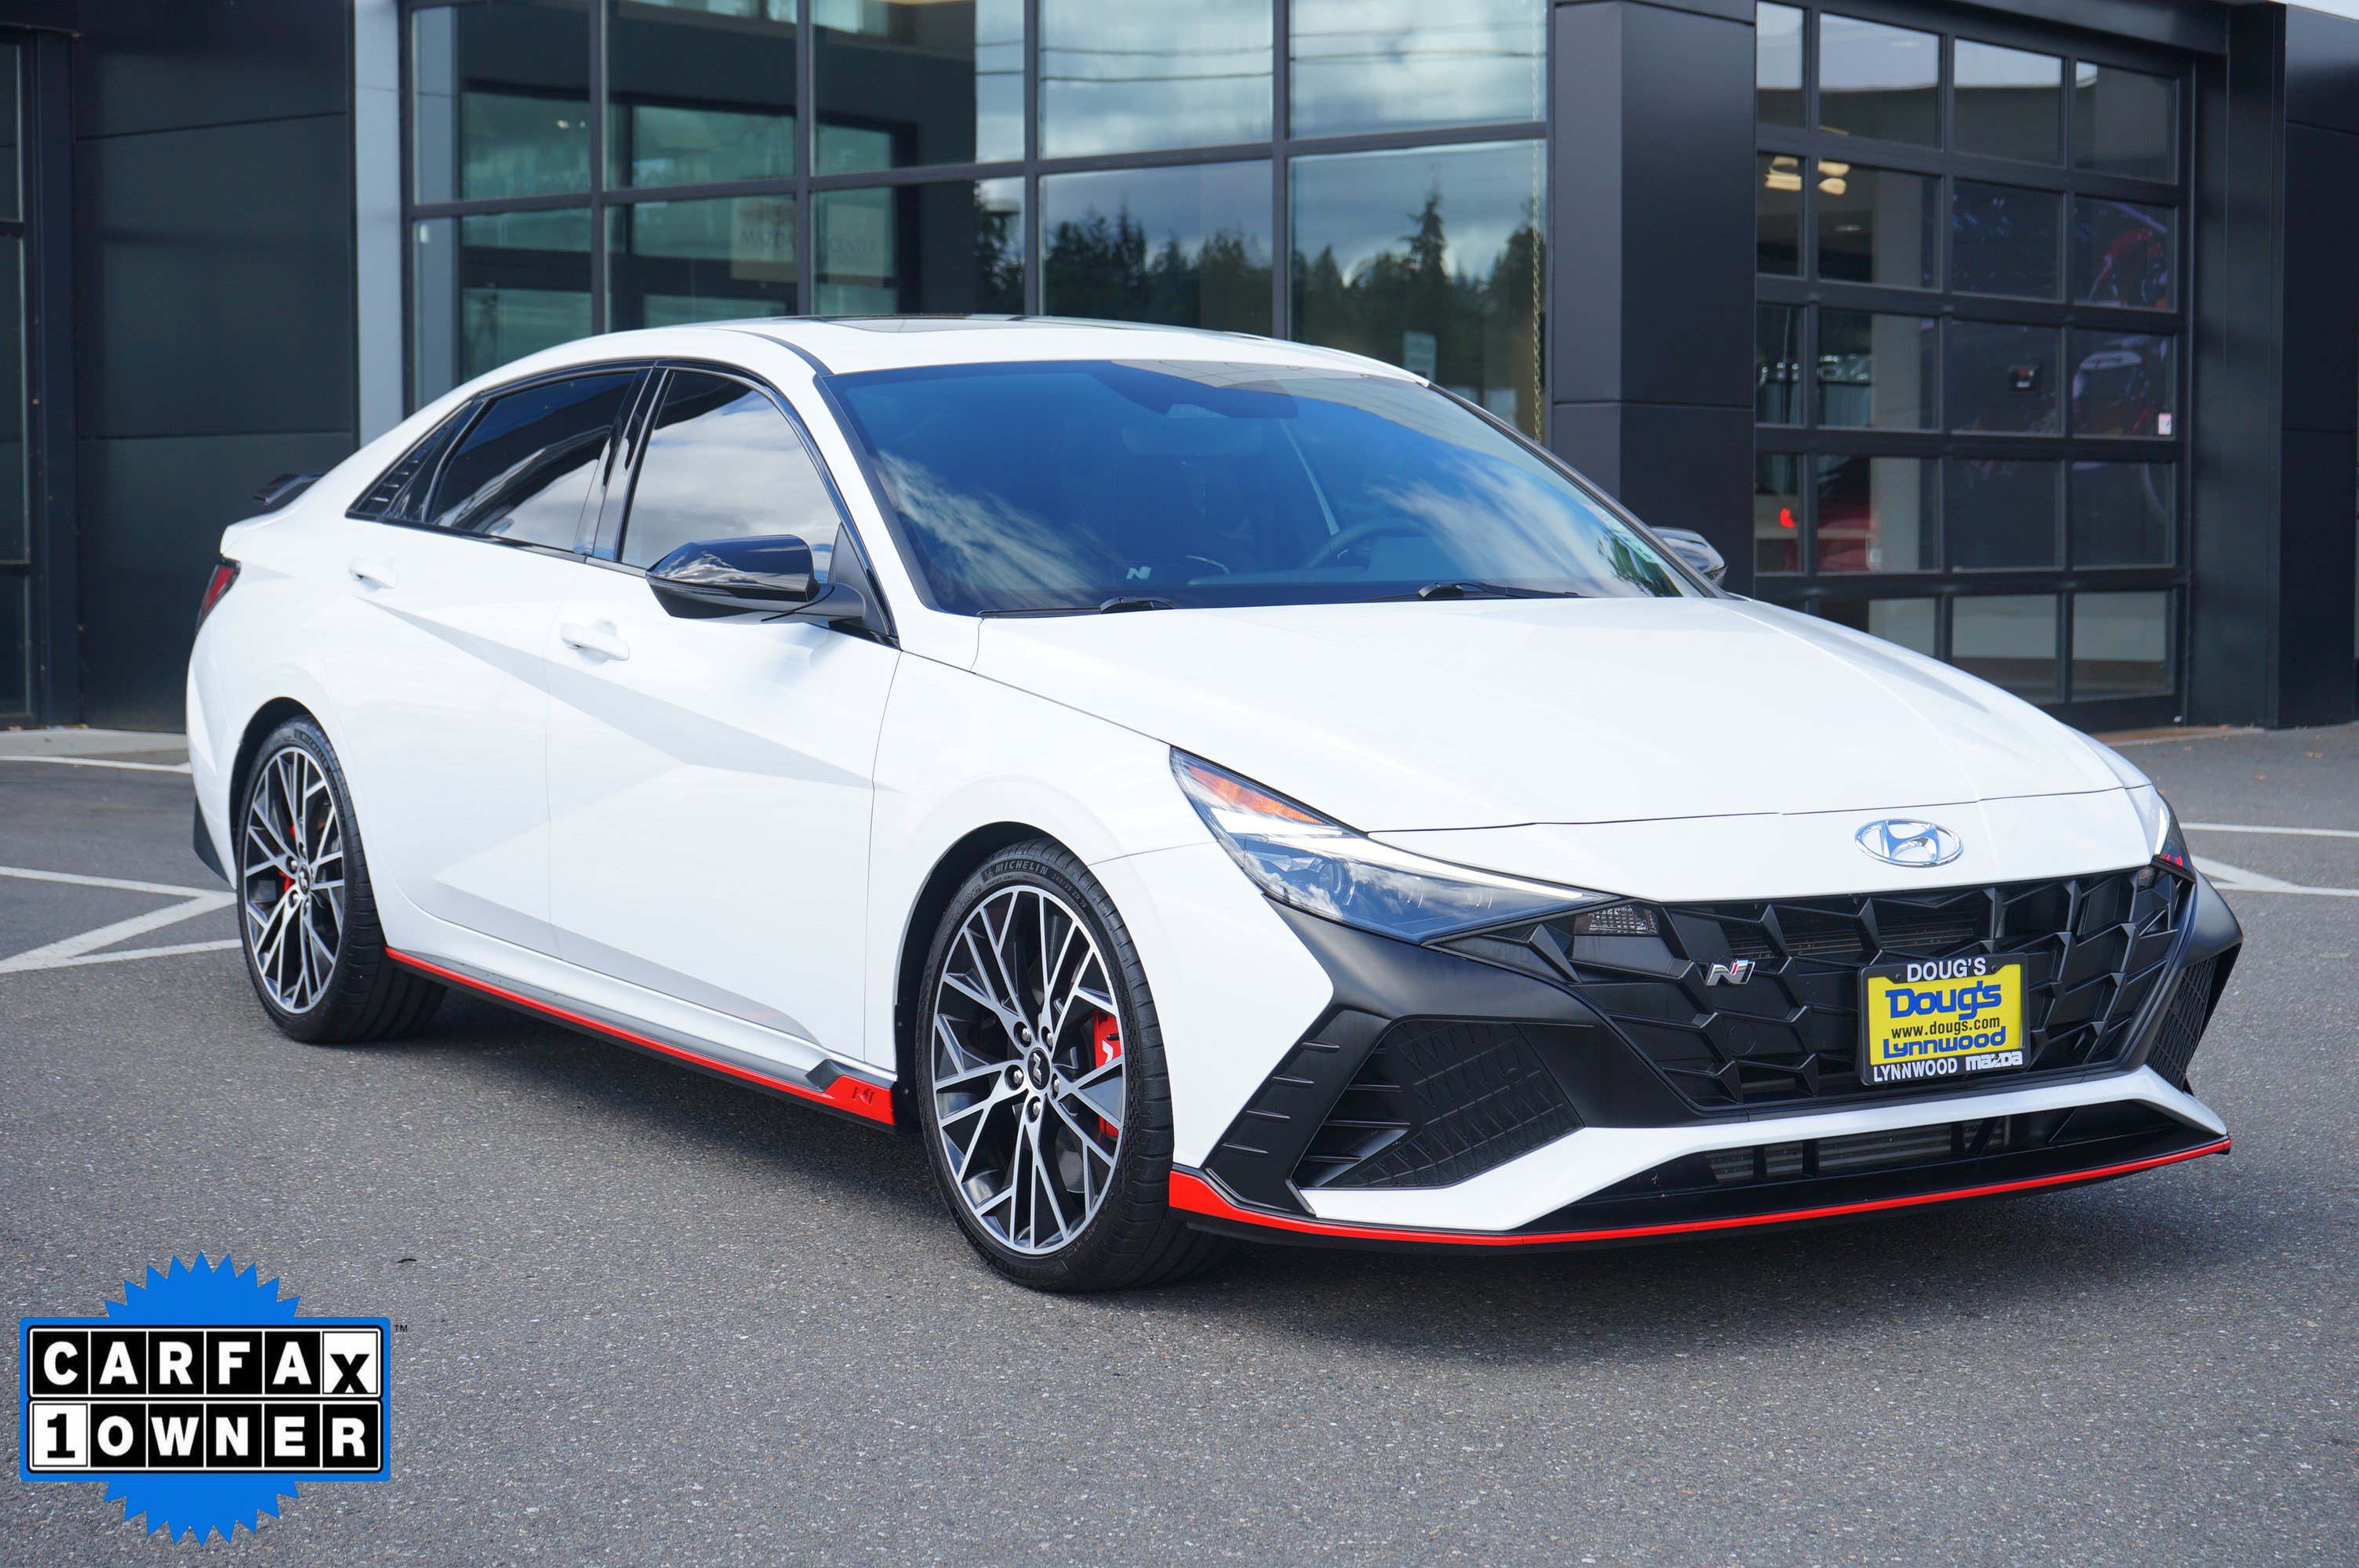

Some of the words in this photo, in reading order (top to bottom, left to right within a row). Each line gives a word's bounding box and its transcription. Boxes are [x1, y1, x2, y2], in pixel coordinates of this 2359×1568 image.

[994, 860, 1049, 876] MICHELIN
[1052, 873, 1072, 891] 245/35
[1906, 957, 1986, 983] DOUG'S
[1885, 981, 2002, 1021] Doug's
[1891, 1017, 2000, 1039] www.dougs.com
[1883, 1025, 2006, 1058] Lynnwood
[1874, 1058, 1958, 1083] LYNNWOOD
